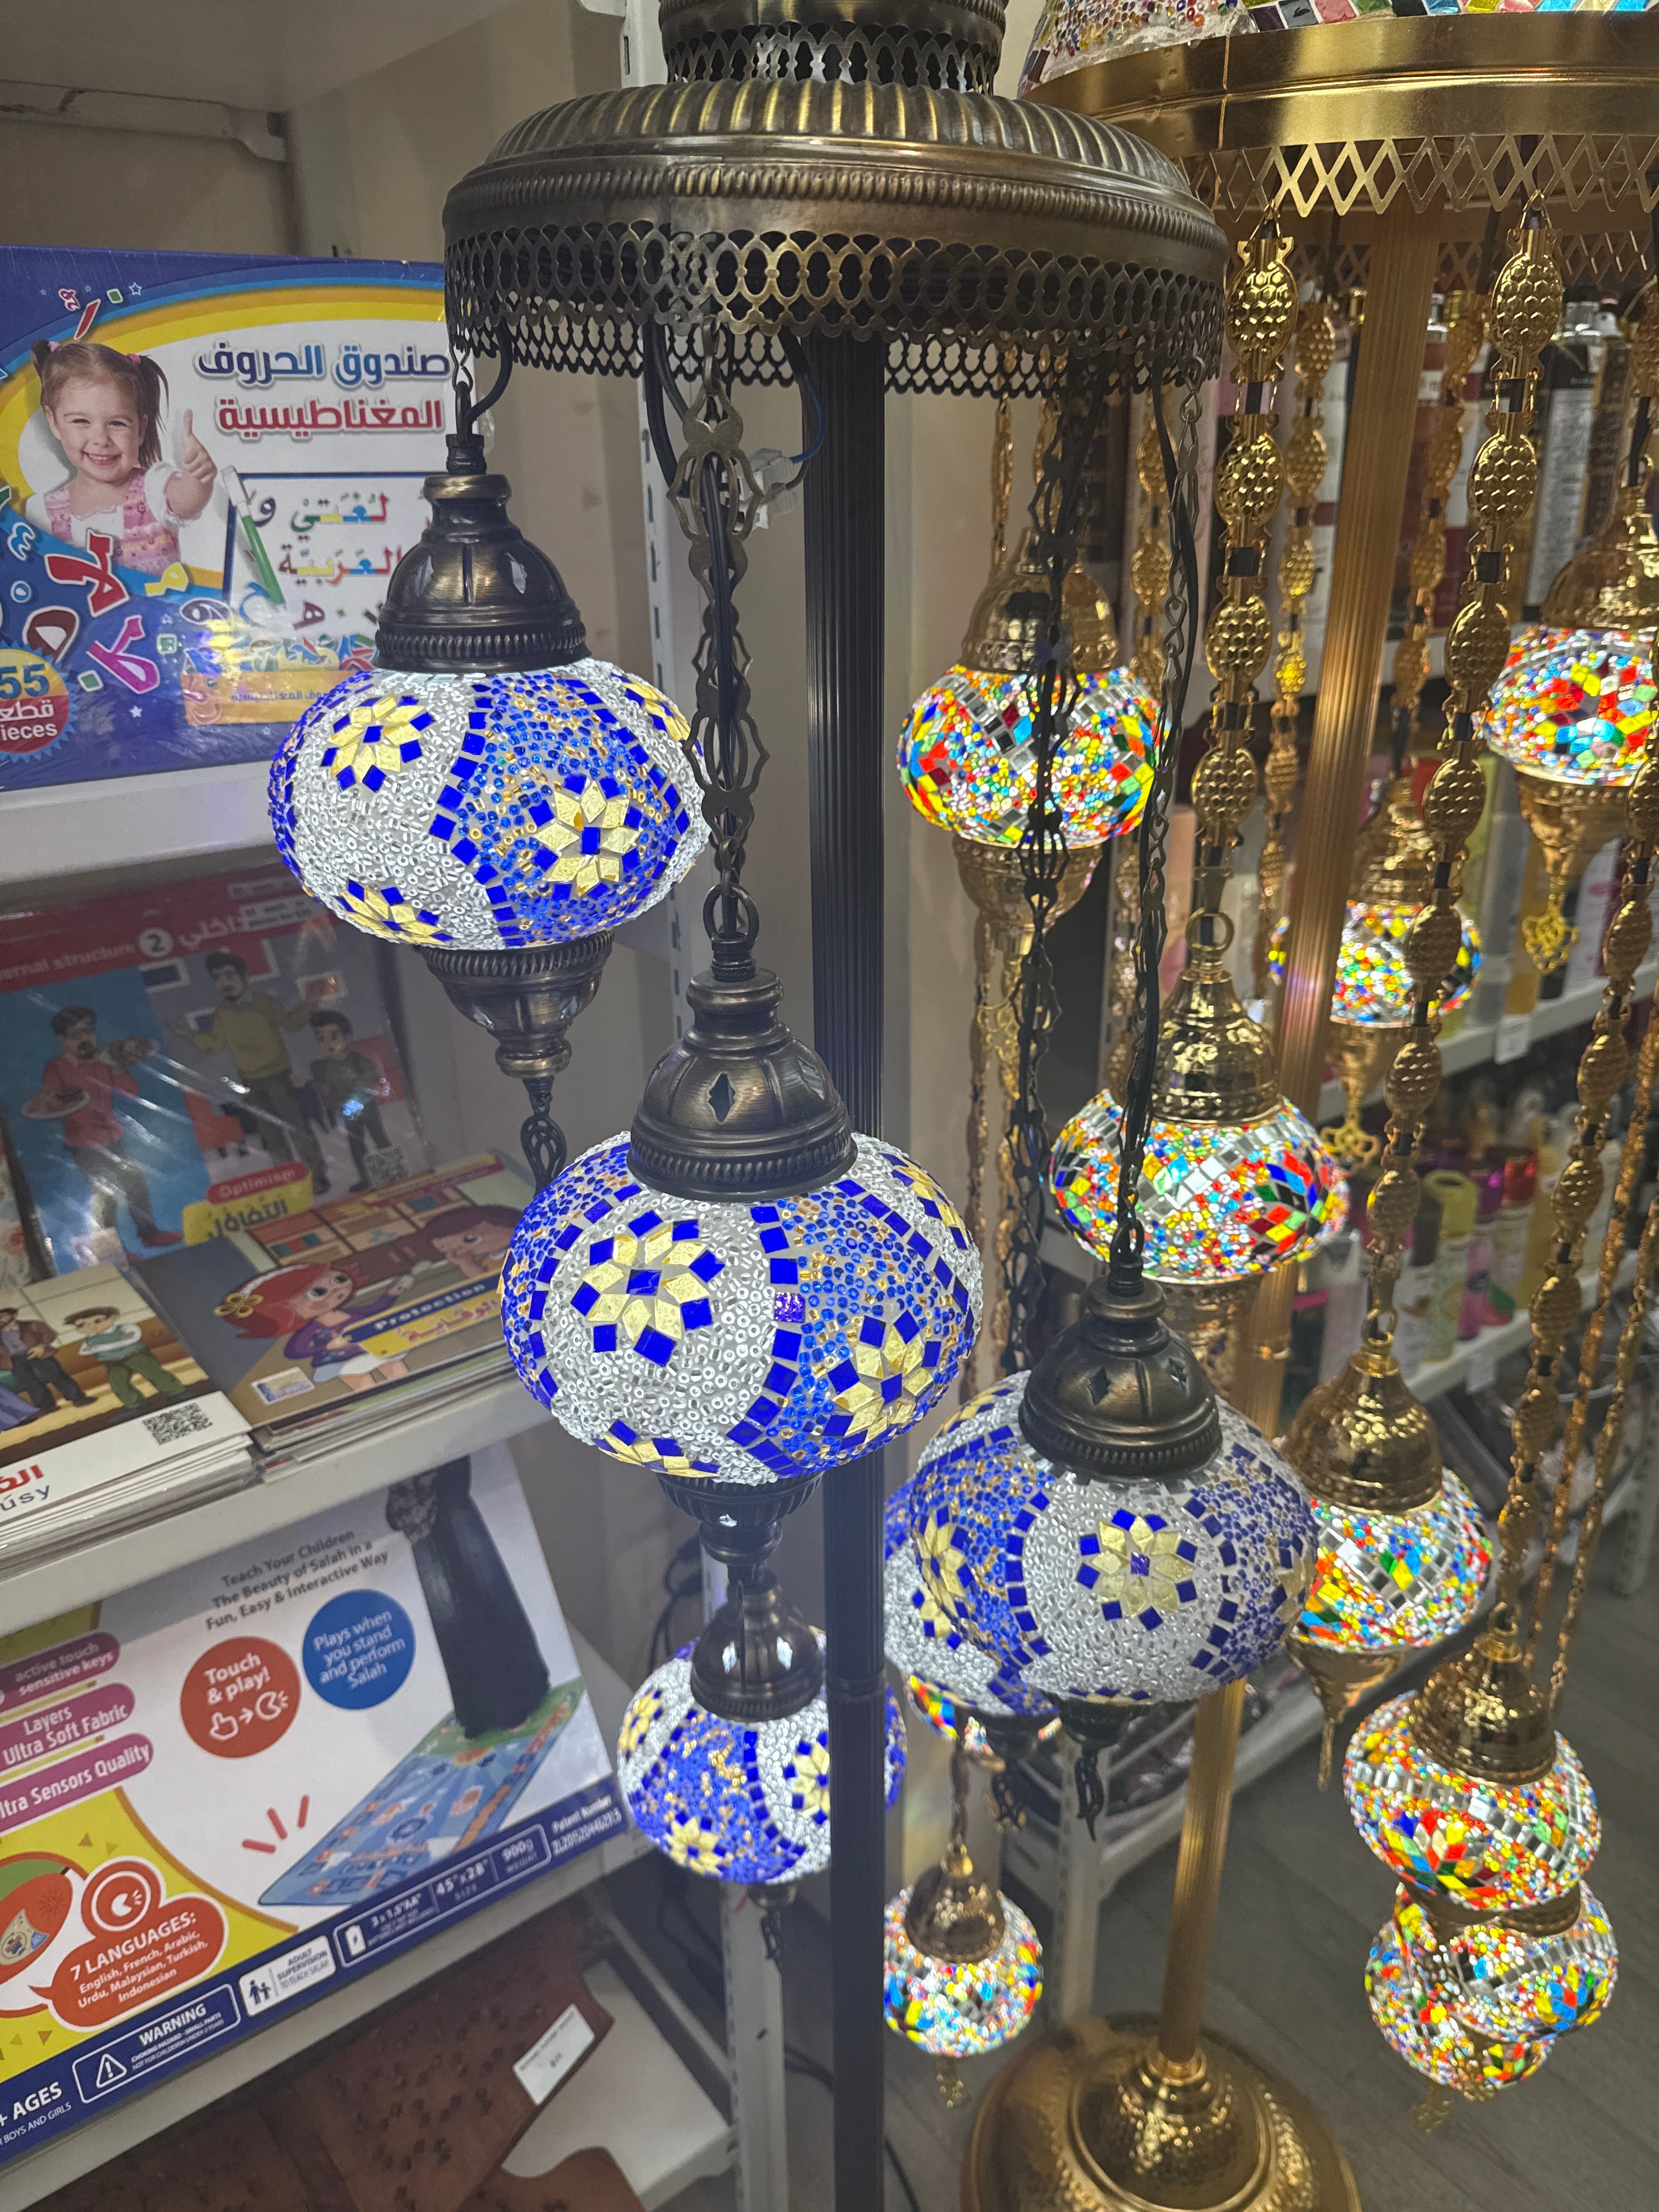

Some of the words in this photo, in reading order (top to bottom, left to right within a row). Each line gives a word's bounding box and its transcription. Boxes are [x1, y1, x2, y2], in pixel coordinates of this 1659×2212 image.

[199, 343, 323, 384] الحروف
[336, 346, 450, 385] صندوق
[219, 399, 443, 437] المغناطيسية
[0, 664, 49, 699] 55
[0, 699, 54, 721] قطع
[1, 723, 58, 741] ieces
[146, 934, 165, 953] 2
[0, 957, 49, 979] ernal
[374, 1284, 486, 1331] Protection
[1, 1485, 50, 1511] usy
[212, 1592, 240, 1608] The
[242, 1572, 291, 1599] Beauty
[294, 1563, 308, 1577] of
[309, 1548, 347, 1571] Salah
[349, 1543, 363, 1556] in
[364, 1541, 373, 1551] a
[222, 1565, 262, 1587] Teach
[264, 1552, 295, 1571] Your
[297, 1530, 356, 1558] Children
[206, 1613, 238, 1630] Fun,
[239, 1598, 272, 1617] Easy
[274, 1590, 285, 1604] &
[287, 1564, 359, 1598] Interactive
[359, 1551, 388, 1570] Way
[313, 1627, 351, 1651] Plays
[351, 1611, 392, 1635] when
[323, 1645, 352, 1668] you
[353, 1624, 392, 1652] stand
[19, 1664, 81, 1696] sensitive
[81, 1652, 114, 1671] keys
[204, 1652, 261, 1686] Touch
[319, 1659, 348, 1685] and
[349, 1638, 405, 1675] perform
[347, 1662, 387, 1690] Salah
[207, 1686, 223, 1705] &
[227, 1668, 270, 1702] play!
[2, 1740, 44, 1766] Ultra
[46, 1722, 80, 1748] Soft
[81, 1704, 128, 1734] Fabric
[24, 1706, 72, 1735] Layers
[0, 1796, 29, 1819] ltra
[31, 1768, 93, 1805] Sensors
[94, 1743, 150, 1777] Quality
[70, 1964, 81, 1982] 7
[85, 1911, 196, 1974] LANGUAGES:
[80, 1968, 122, 1994] English,
[123, 1949, 163, 1972] French,
[164, 1931, 201, 1953] Arabic,
[278, 1950, 328, 1981] SUPERVISION
[289, 1948, 312, 1966] ADULT
[78, 1989, 109, 2008] Urdu,
[110, 1961, 167, 1992] Malaysian,
[167, 1940, 208, 1964] Turkish,
[119, 1969, 177, 2002] Indonesian
[139, 2003, 206, 2046] WARNING
[131, 2045, 158, 2063] CHOKING
[158, 2033, 182, 2049] HAZARD
[14, 2081, 62, 2120] AGES
[3, 2125, 26, 2143] BOYS
[28, 2115, 47, 2131] AND
[48, 2102, 72, 2120] GIRLS
